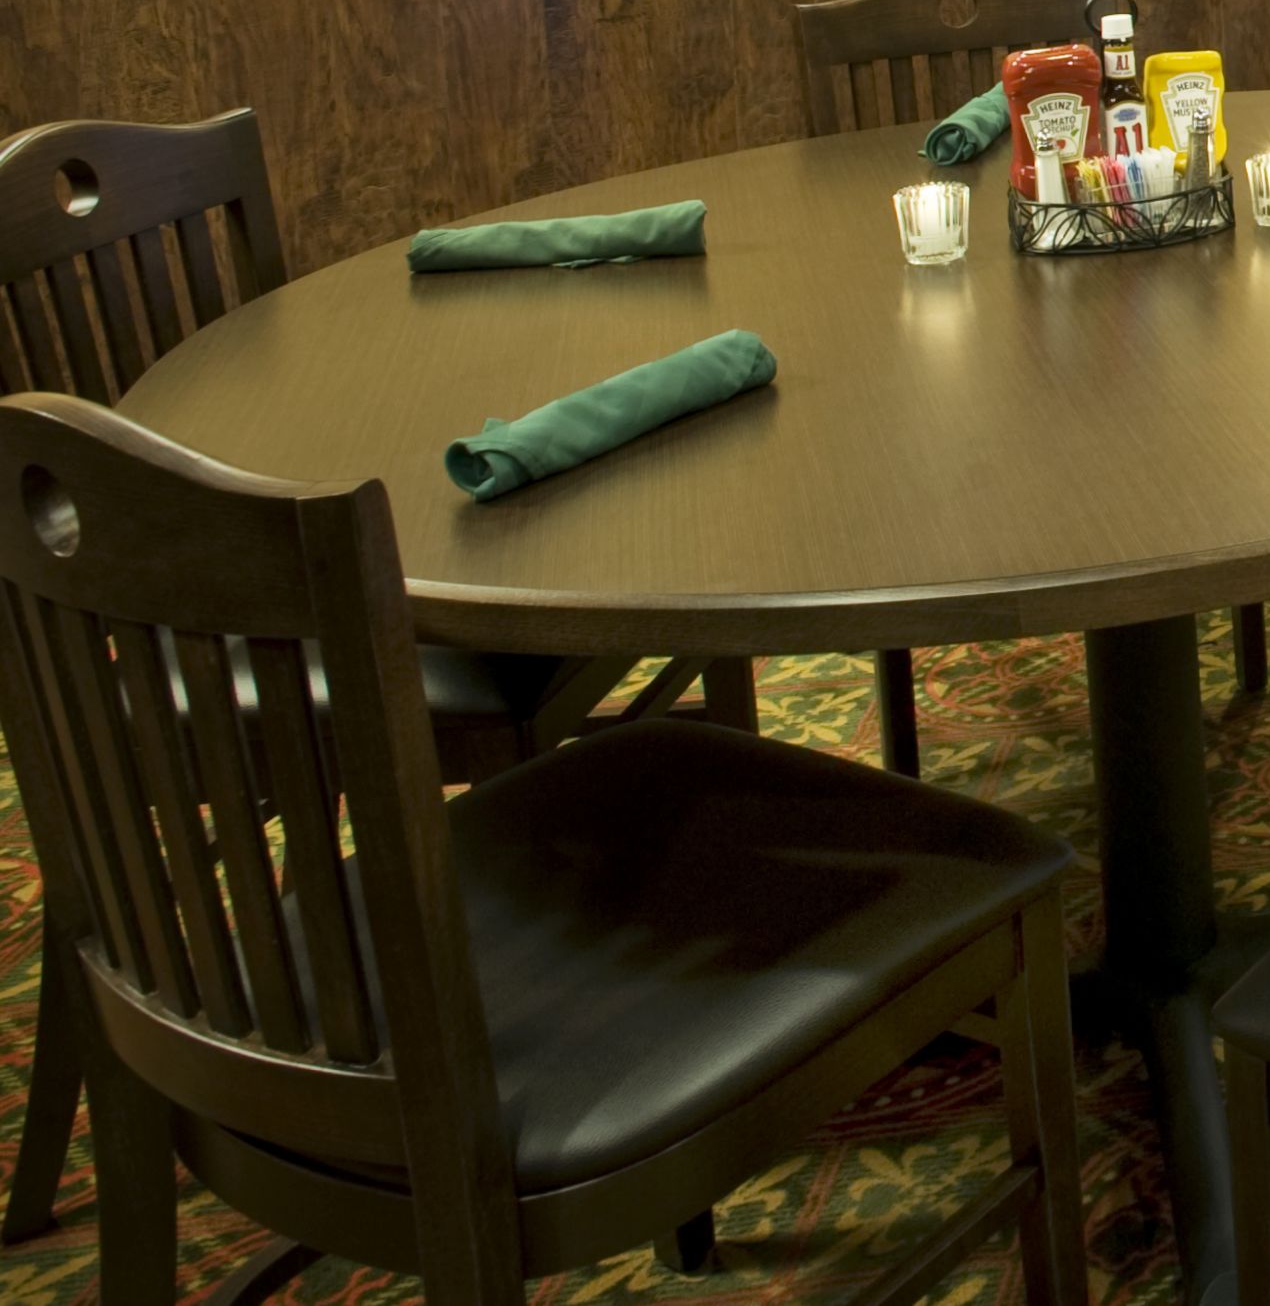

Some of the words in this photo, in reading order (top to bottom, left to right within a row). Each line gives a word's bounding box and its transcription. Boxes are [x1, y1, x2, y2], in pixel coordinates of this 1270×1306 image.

[1177, 80, 1205, 92] HEINZ
[1040, 101, 1072, 114] HEINZ
[1174, 97, 1209, 108] YELLOW
[1039, 115, 1076, 128] TOMATO
